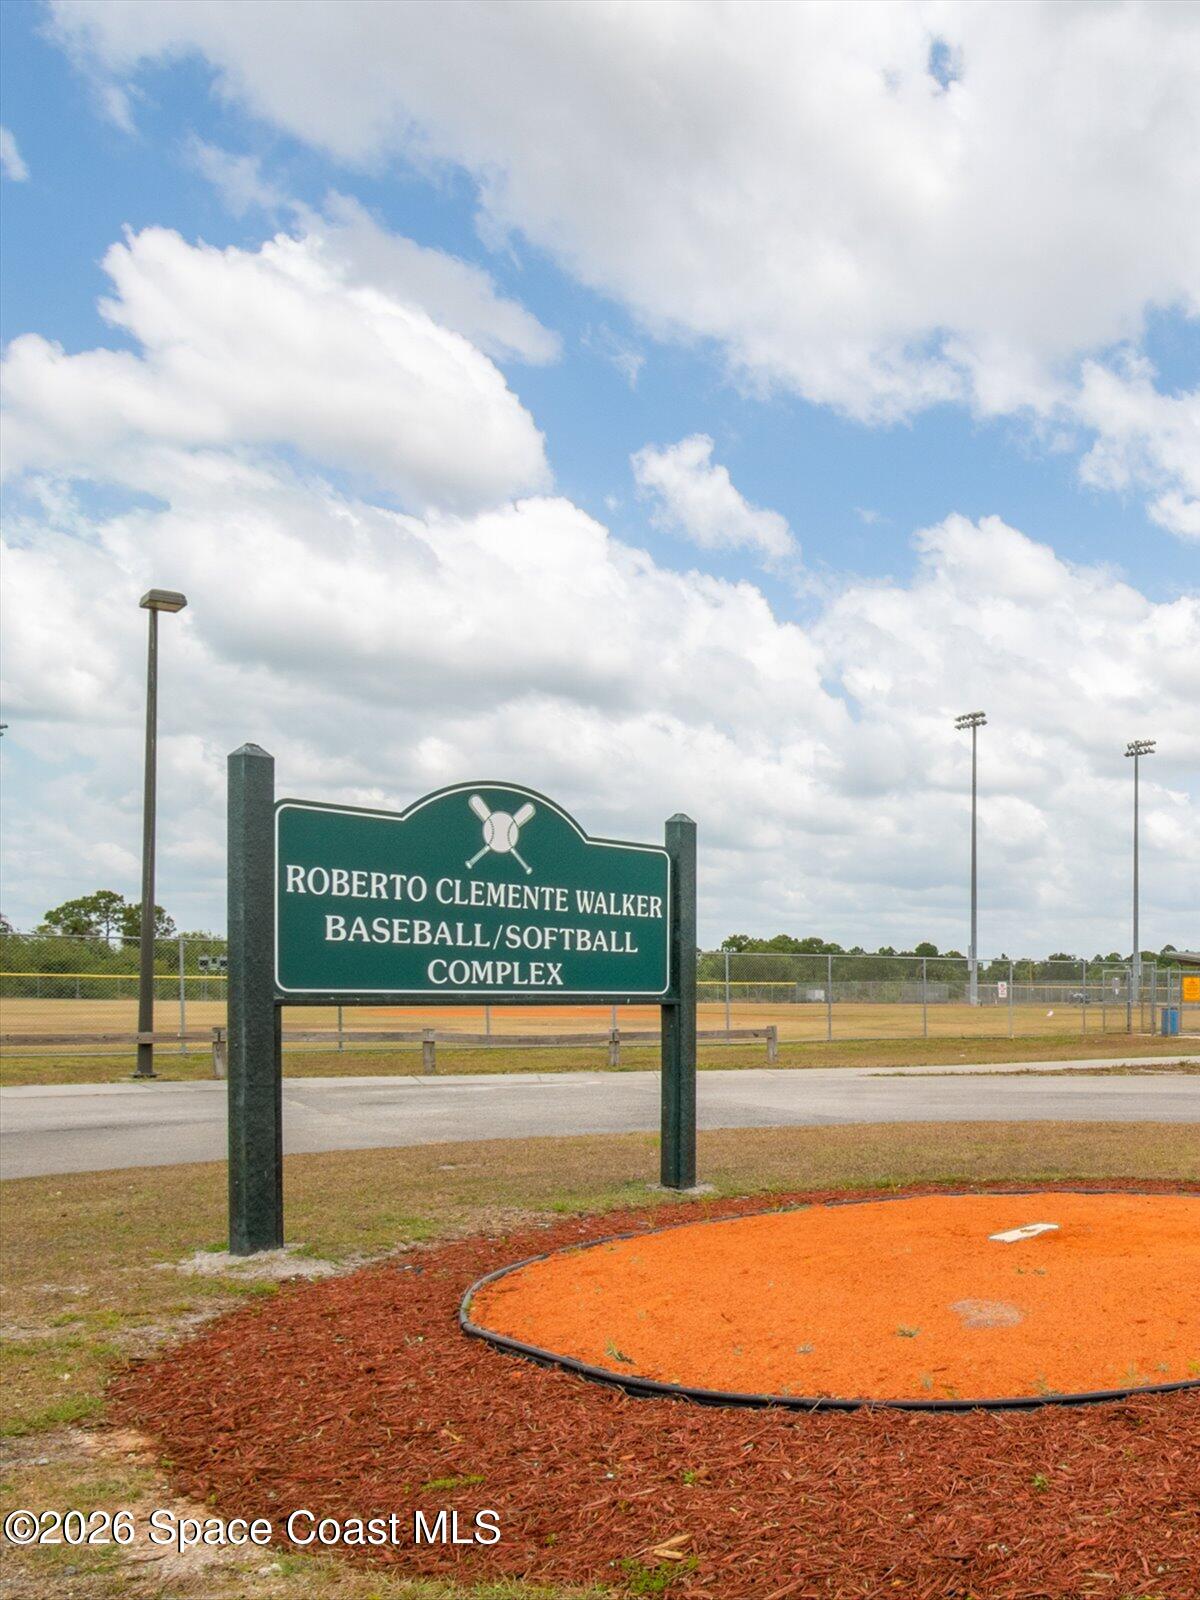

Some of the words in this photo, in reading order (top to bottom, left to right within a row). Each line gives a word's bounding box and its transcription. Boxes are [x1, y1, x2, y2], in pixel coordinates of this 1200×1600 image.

[286, 864, 428, 902] ROBERTO
[436, 878, 569, 912] CLEMENTE
[576, 889, 663, 918] WALKER
[325, 915, 639, 953] BASEBALL/SOFTBALL
[427, 959, 564, 985] COMPLEX
